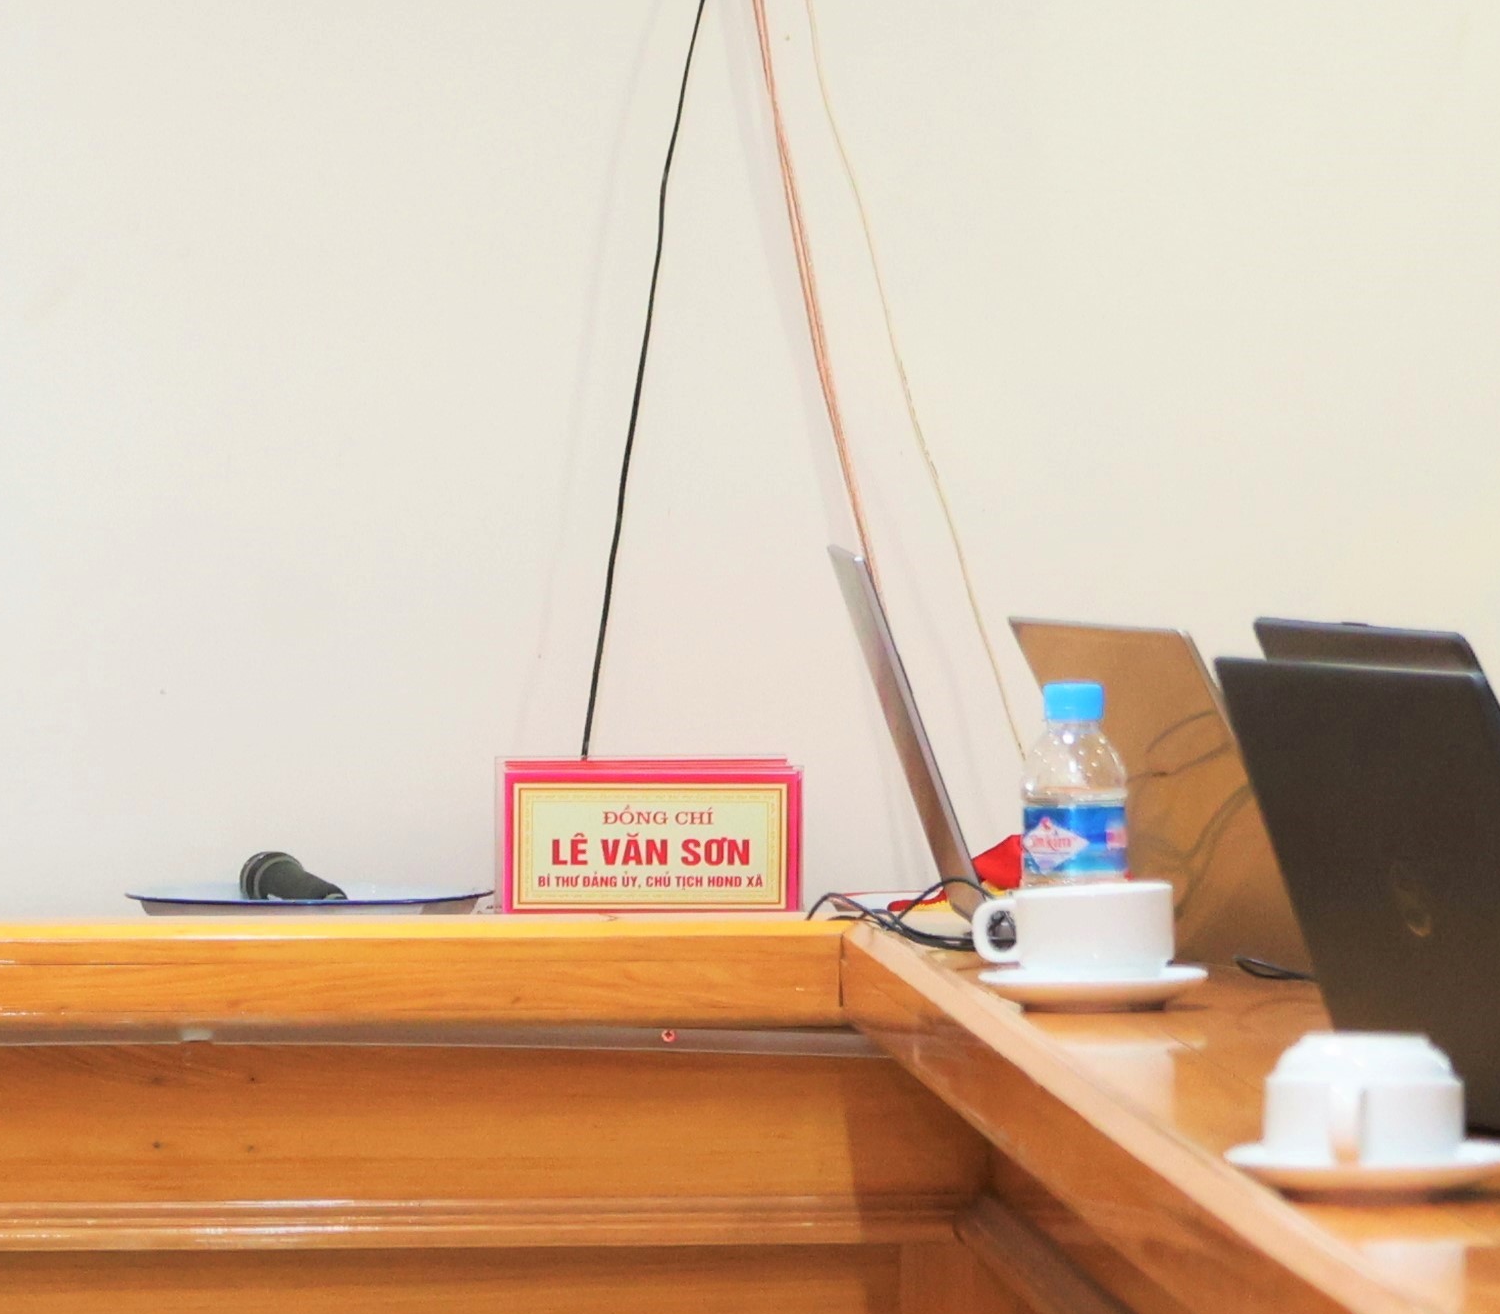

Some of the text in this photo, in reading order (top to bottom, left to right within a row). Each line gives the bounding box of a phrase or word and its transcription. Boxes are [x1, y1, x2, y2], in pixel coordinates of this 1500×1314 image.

[602, 804, 714, 825] ĐỒNG CHÍ
[551, 832, 750, 866] LÊ VĂN SƠN
[538, 873, 551, 888] BÍ
[555, 874, 580, 888] THƯ
[582, 871, 618, 888] ĐẢNG
[645, 871, 671, 888] CHỦ
[675, 875, 703, 891] TỊCH
[707, 875, 743, 888] HĐND
